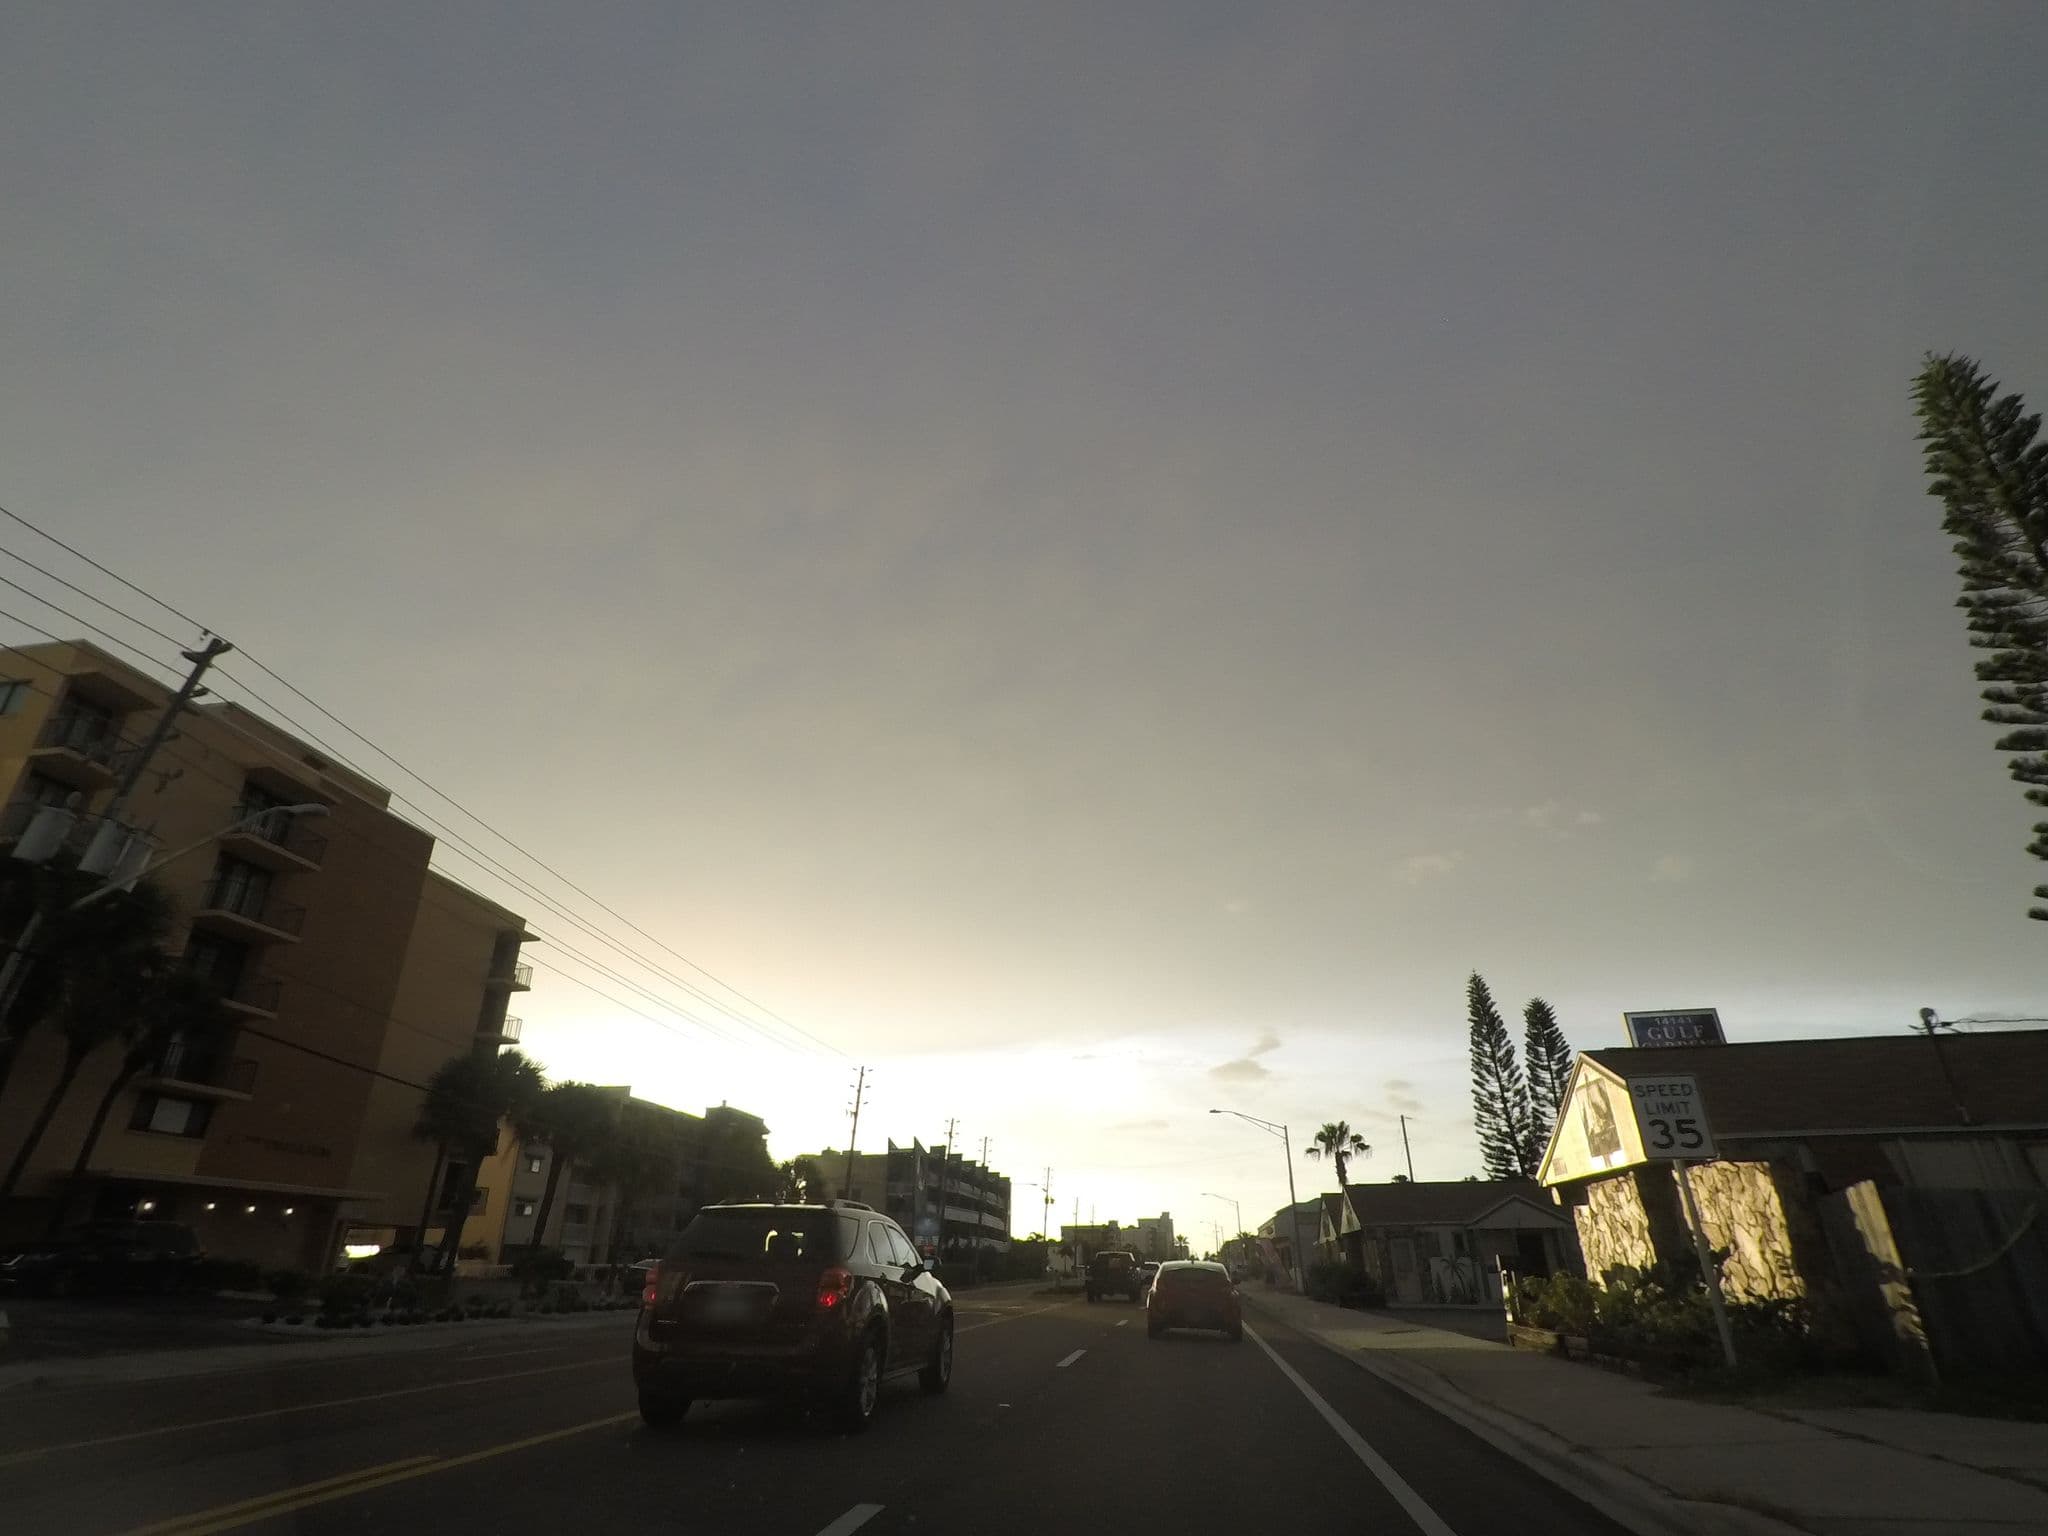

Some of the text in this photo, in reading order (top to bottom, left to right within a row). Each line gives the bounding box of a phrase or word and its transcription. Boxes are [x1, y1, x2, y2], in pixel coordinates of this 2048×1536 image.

[1647, 1024, 1704, 1040] GULF
[1634, 1083, 1693, 1098] SPEED
[1644, 1101, 1690, 1115] LIMIT
[1648, 1118, 1704, 1149] 35
